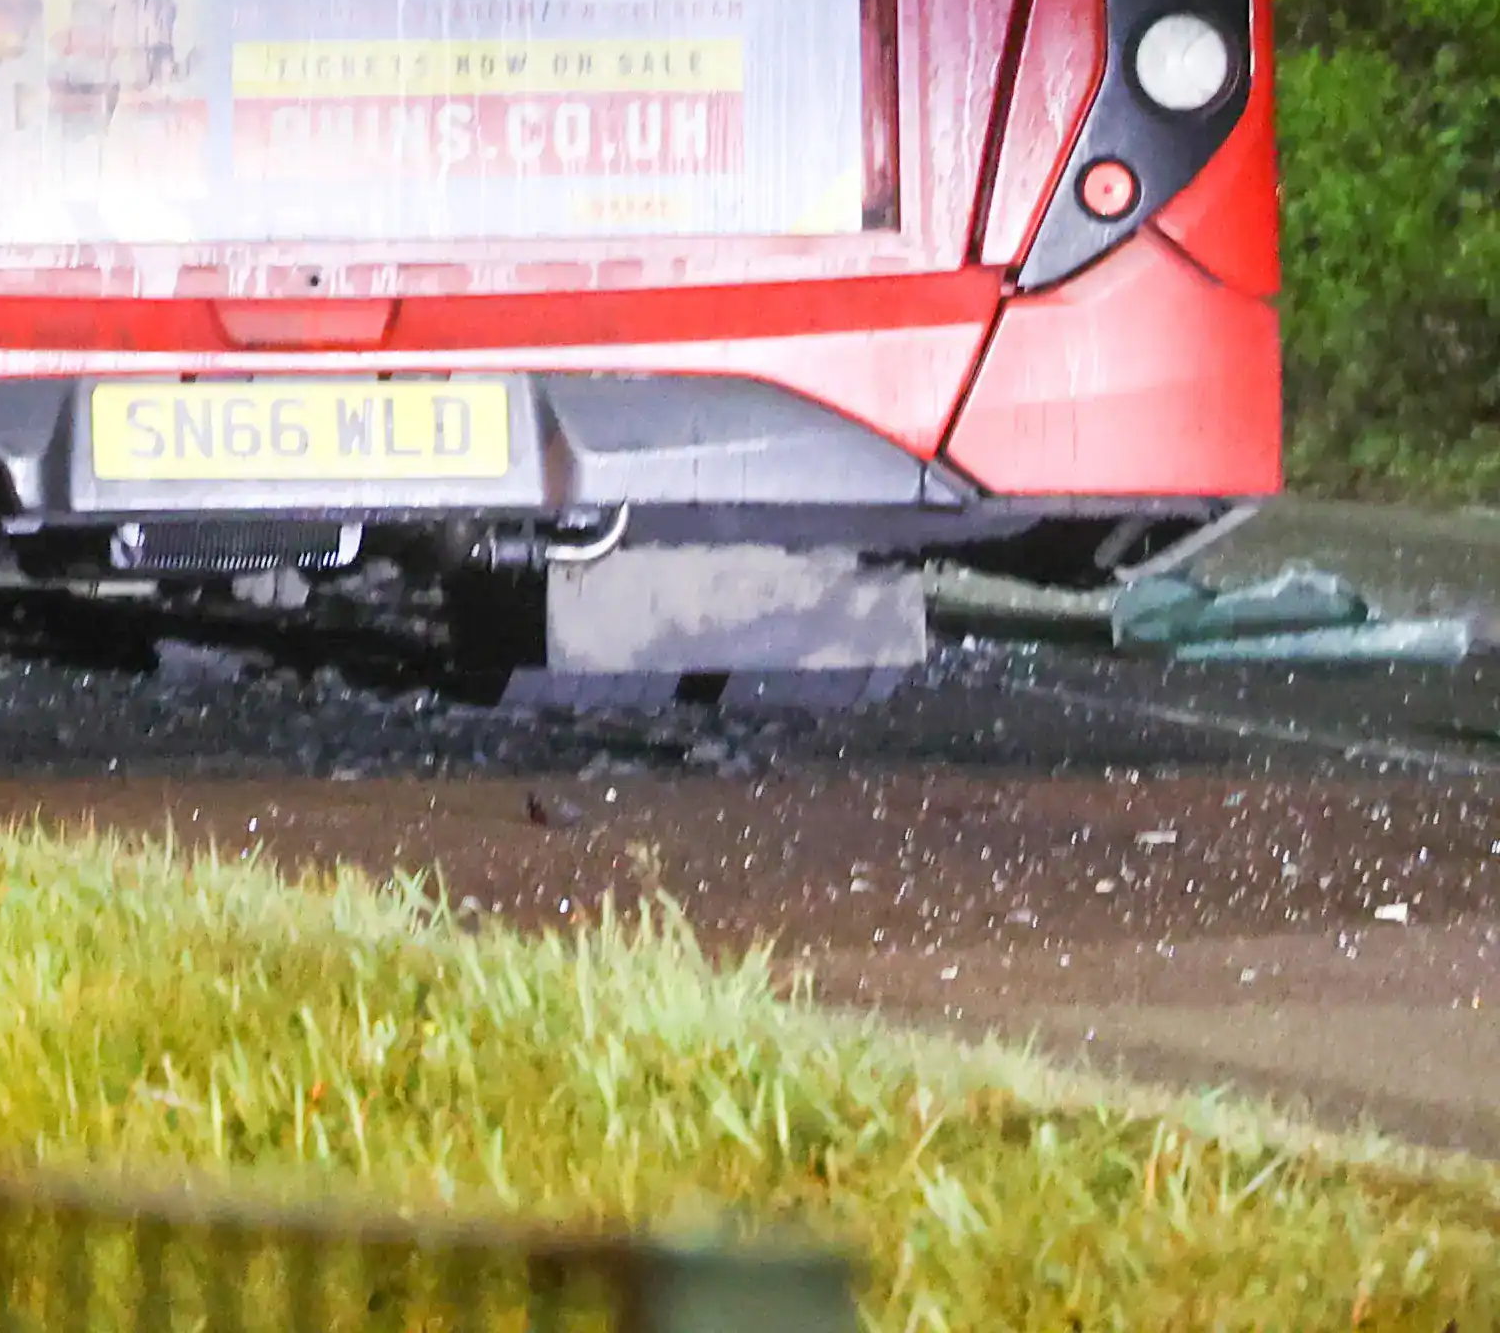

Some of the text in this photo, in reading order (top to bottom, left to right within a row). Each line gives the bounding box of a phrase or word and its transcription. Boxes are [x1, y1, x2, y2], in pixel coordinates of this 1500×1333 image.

[456, 52, 527, 77] NOW
[618, 50, 702, 76] SALE
[126, 395, 472, 459] SN66 WLD
